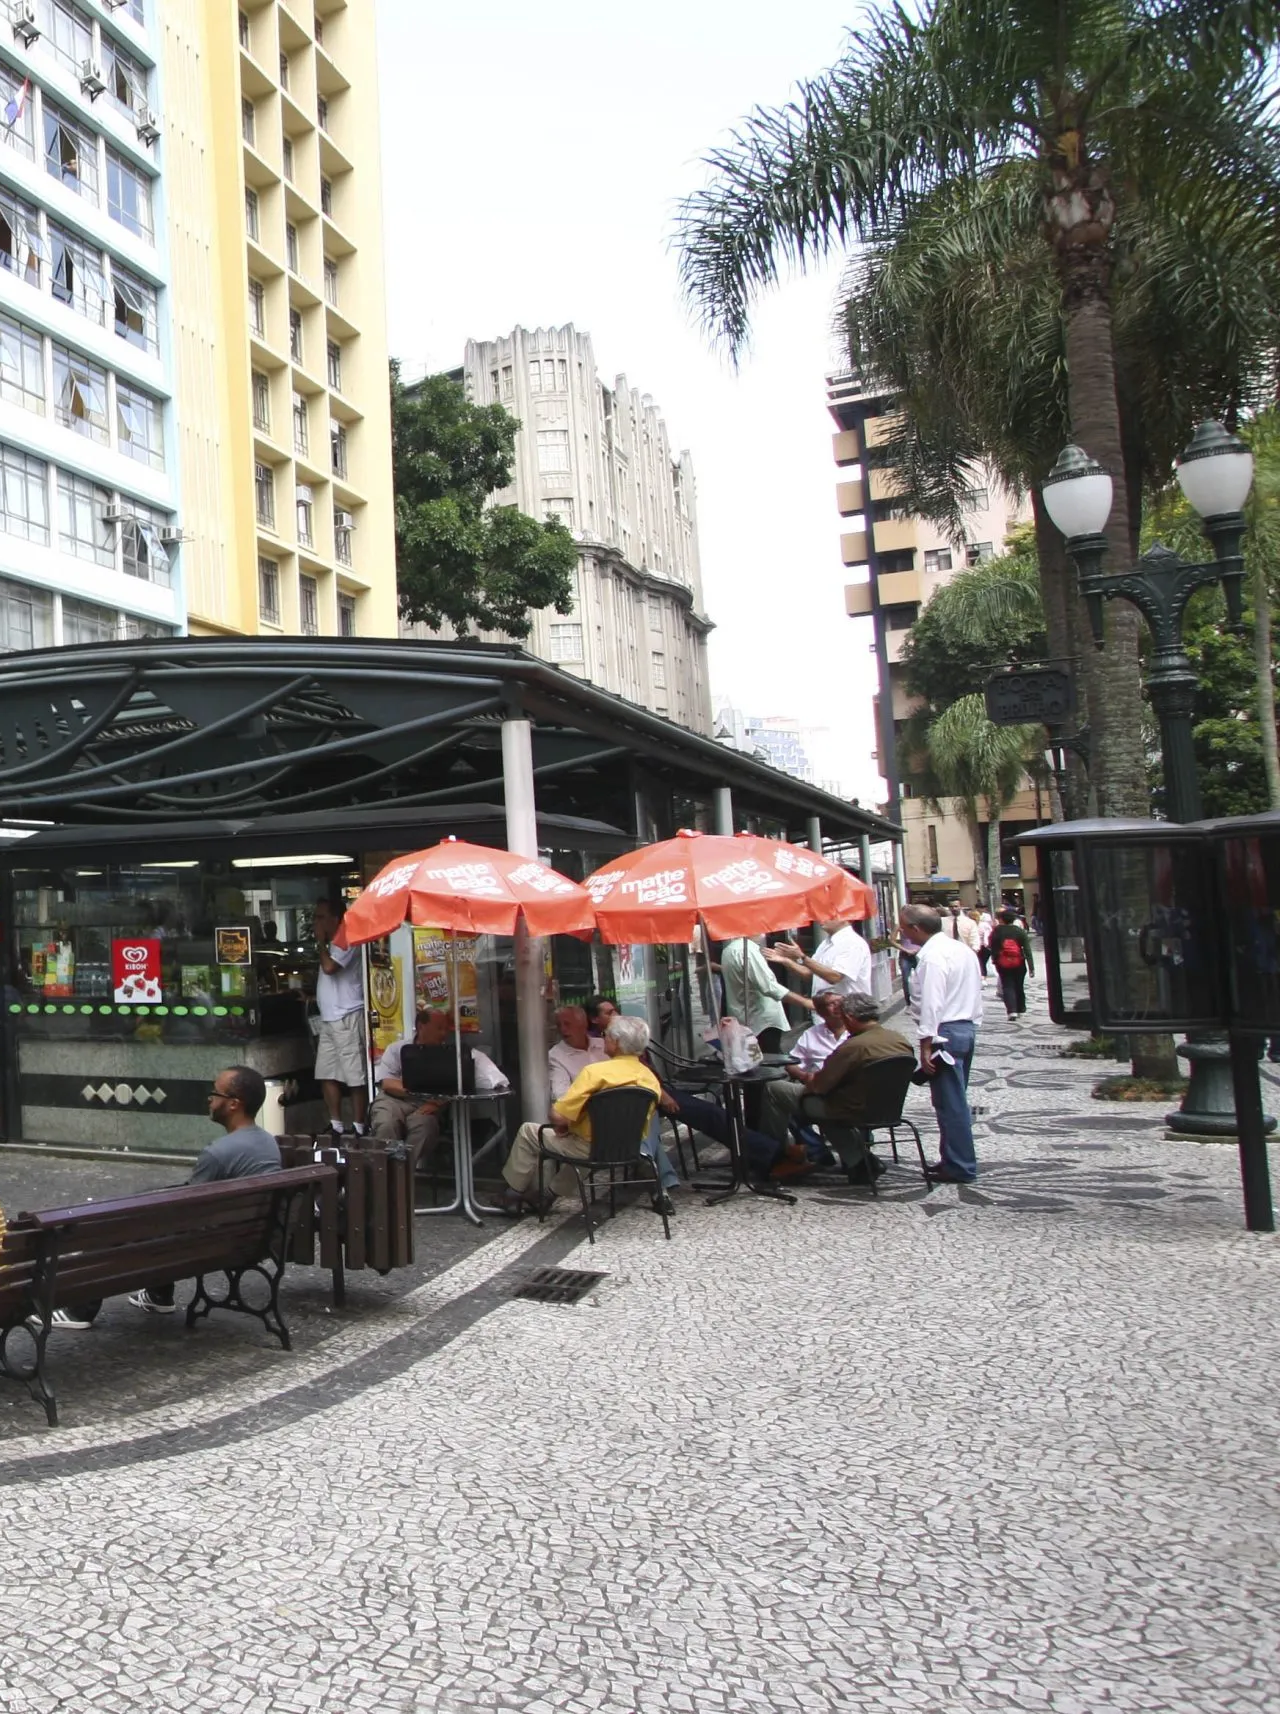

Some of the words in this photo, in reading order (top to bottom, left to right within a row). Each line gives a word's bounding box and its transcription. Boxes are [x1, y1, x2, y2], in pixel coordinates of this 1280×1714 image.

[425, 864, 490, 880] matte
[622, 869, 686, 894] matte
[700, 859, 759, 888] matte
